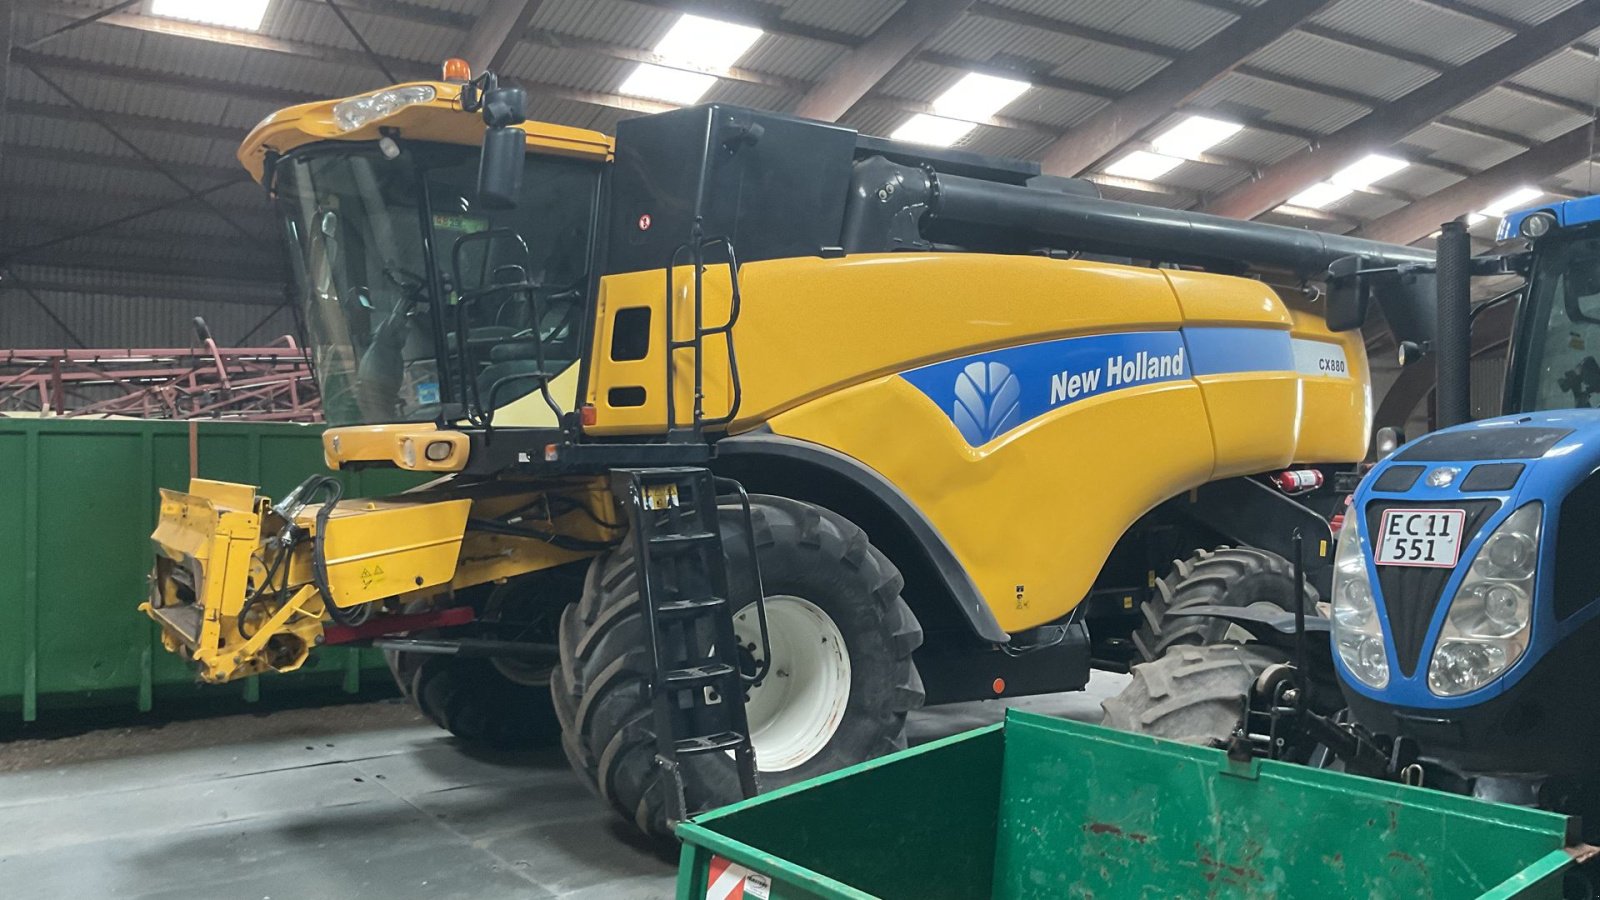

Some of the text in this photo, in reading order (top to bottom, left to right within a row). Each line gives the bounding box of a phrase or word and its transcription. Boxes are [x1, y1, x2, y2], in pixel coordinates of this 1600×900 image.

[1050, 347, 1184, 405] New Holland
[1318, 358, 1345, 373] CX880
[1392, 538, 1436, 562] 551
